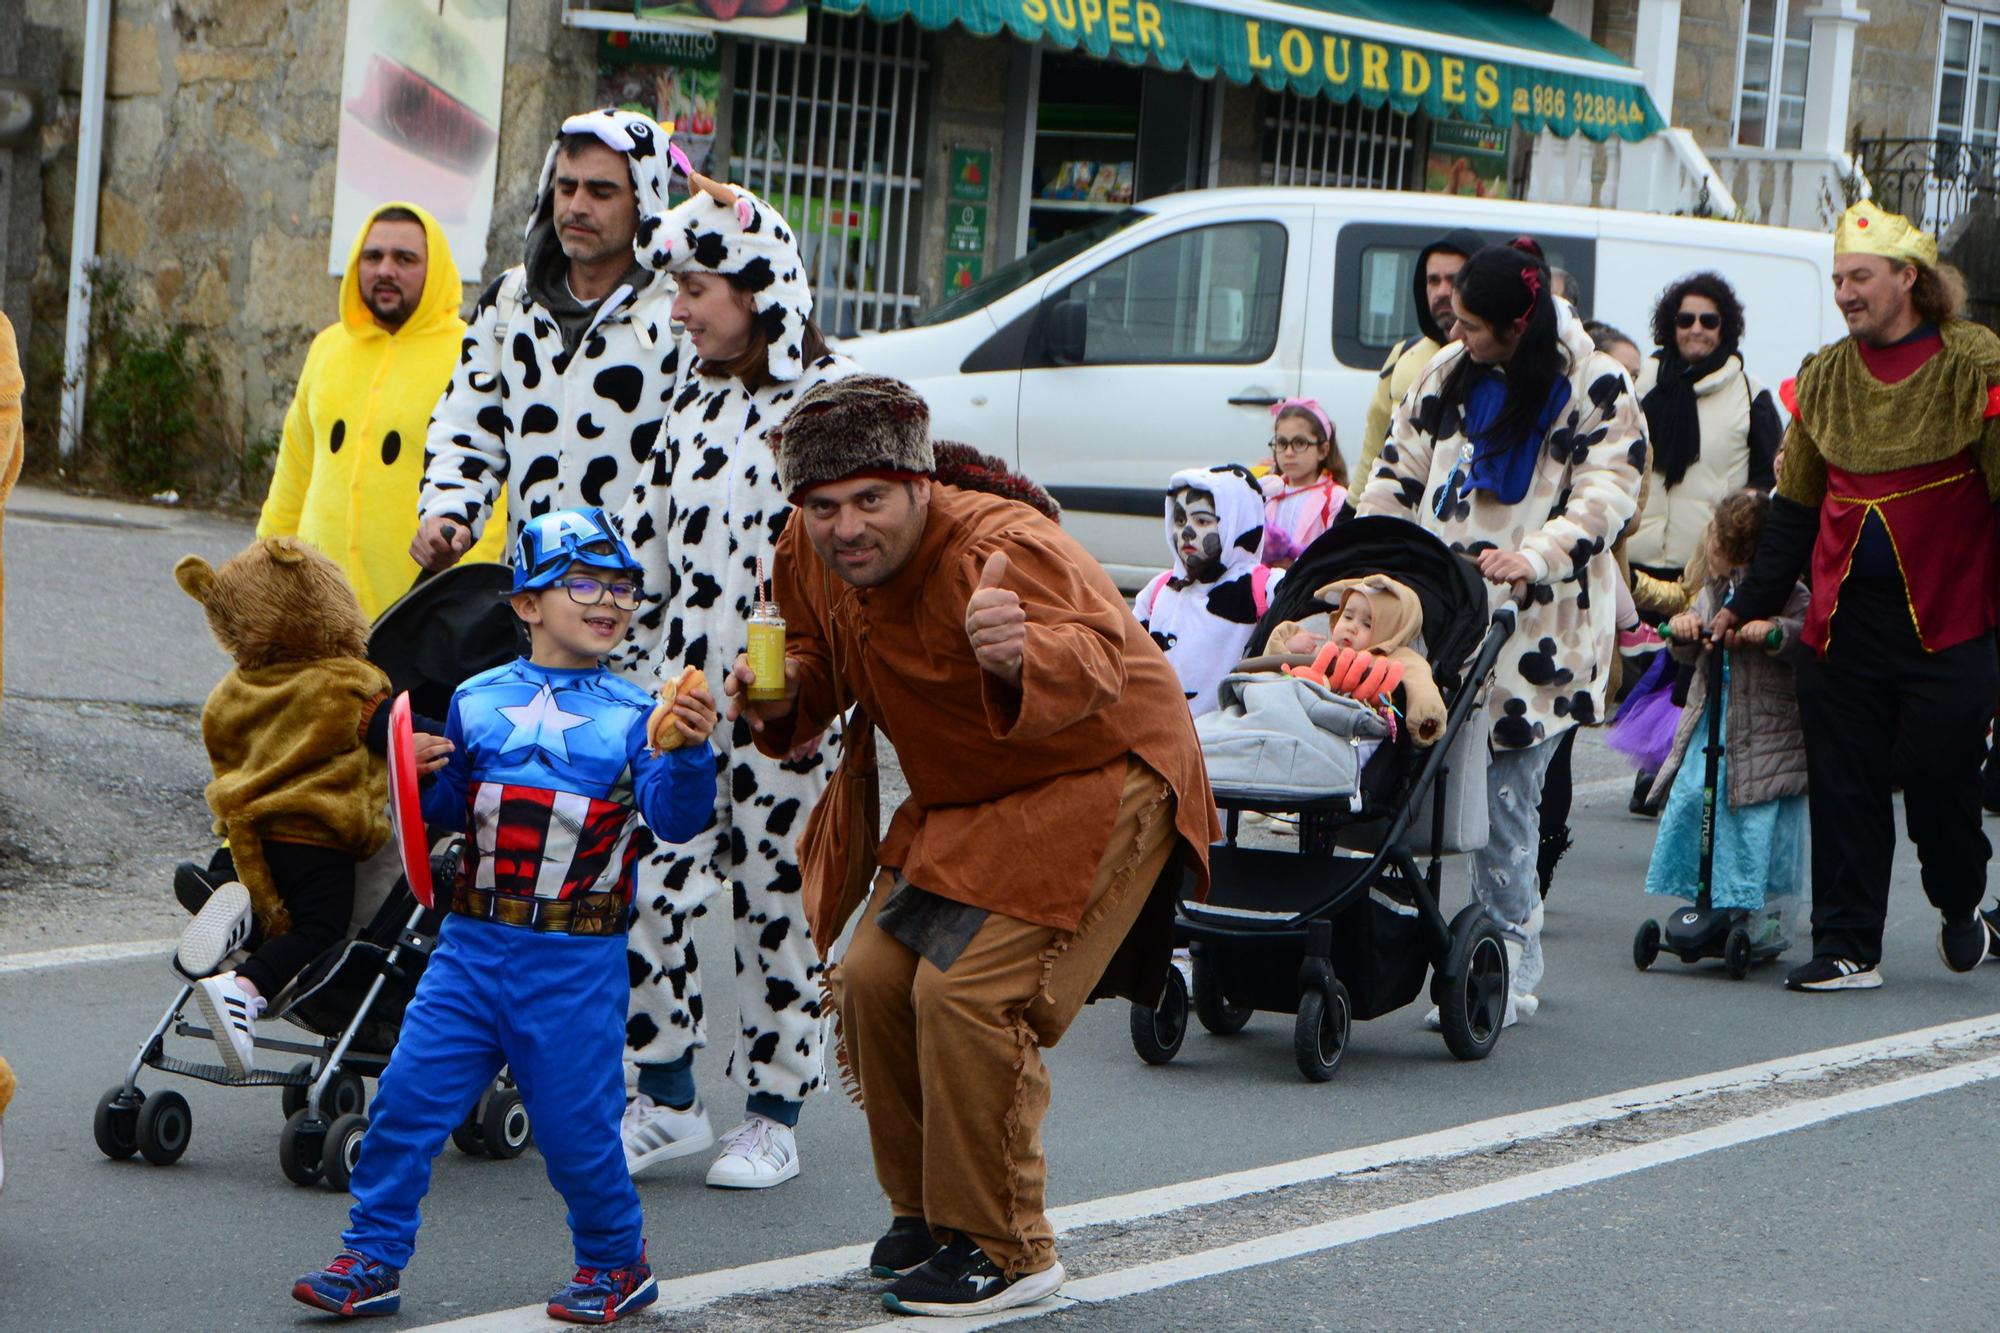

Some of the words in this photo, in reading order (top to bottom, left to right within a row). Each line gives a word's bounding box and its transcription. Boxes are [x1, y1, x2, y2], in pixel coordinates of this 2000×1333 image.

[1245, 20, 1500, 109] LOURDES
[1532, 84, 1566, 119] 986
[541, 512, 600, 554] A
